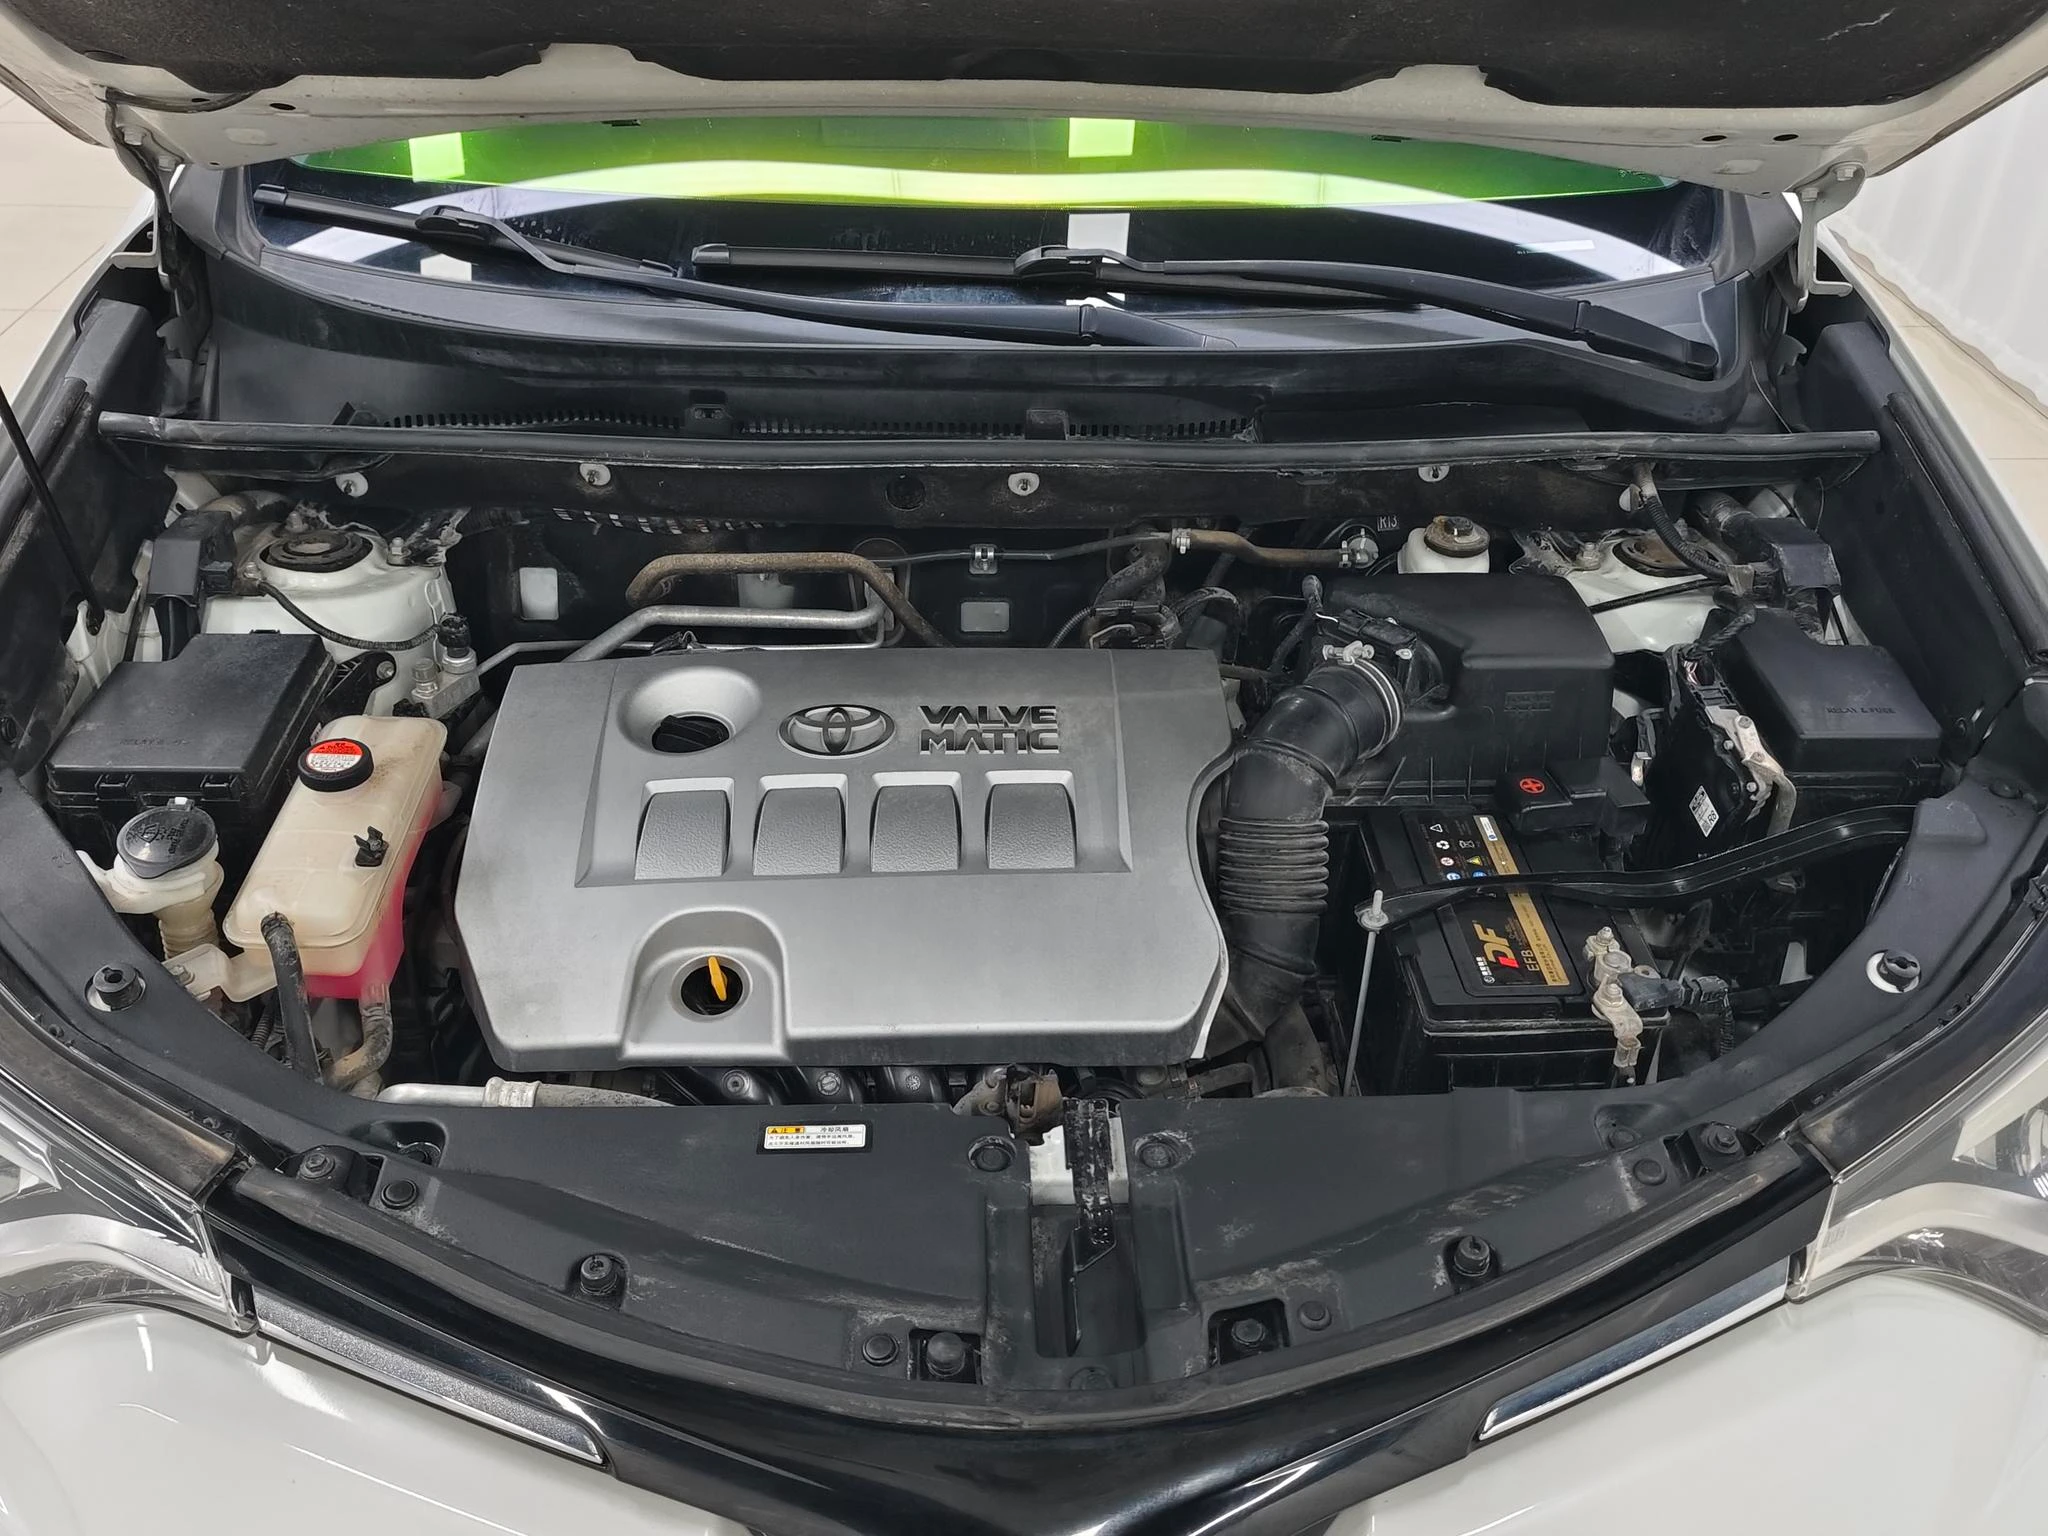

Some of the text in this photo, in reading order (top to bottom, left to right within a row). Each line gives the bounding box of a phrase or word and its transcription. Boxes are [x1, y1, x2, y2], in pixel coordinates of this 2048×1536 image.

[918, 705, 1058, 728] VALVE
[920, 729, 1059, 755] MATIC
[1521, 949, 1540, 971] EFB
